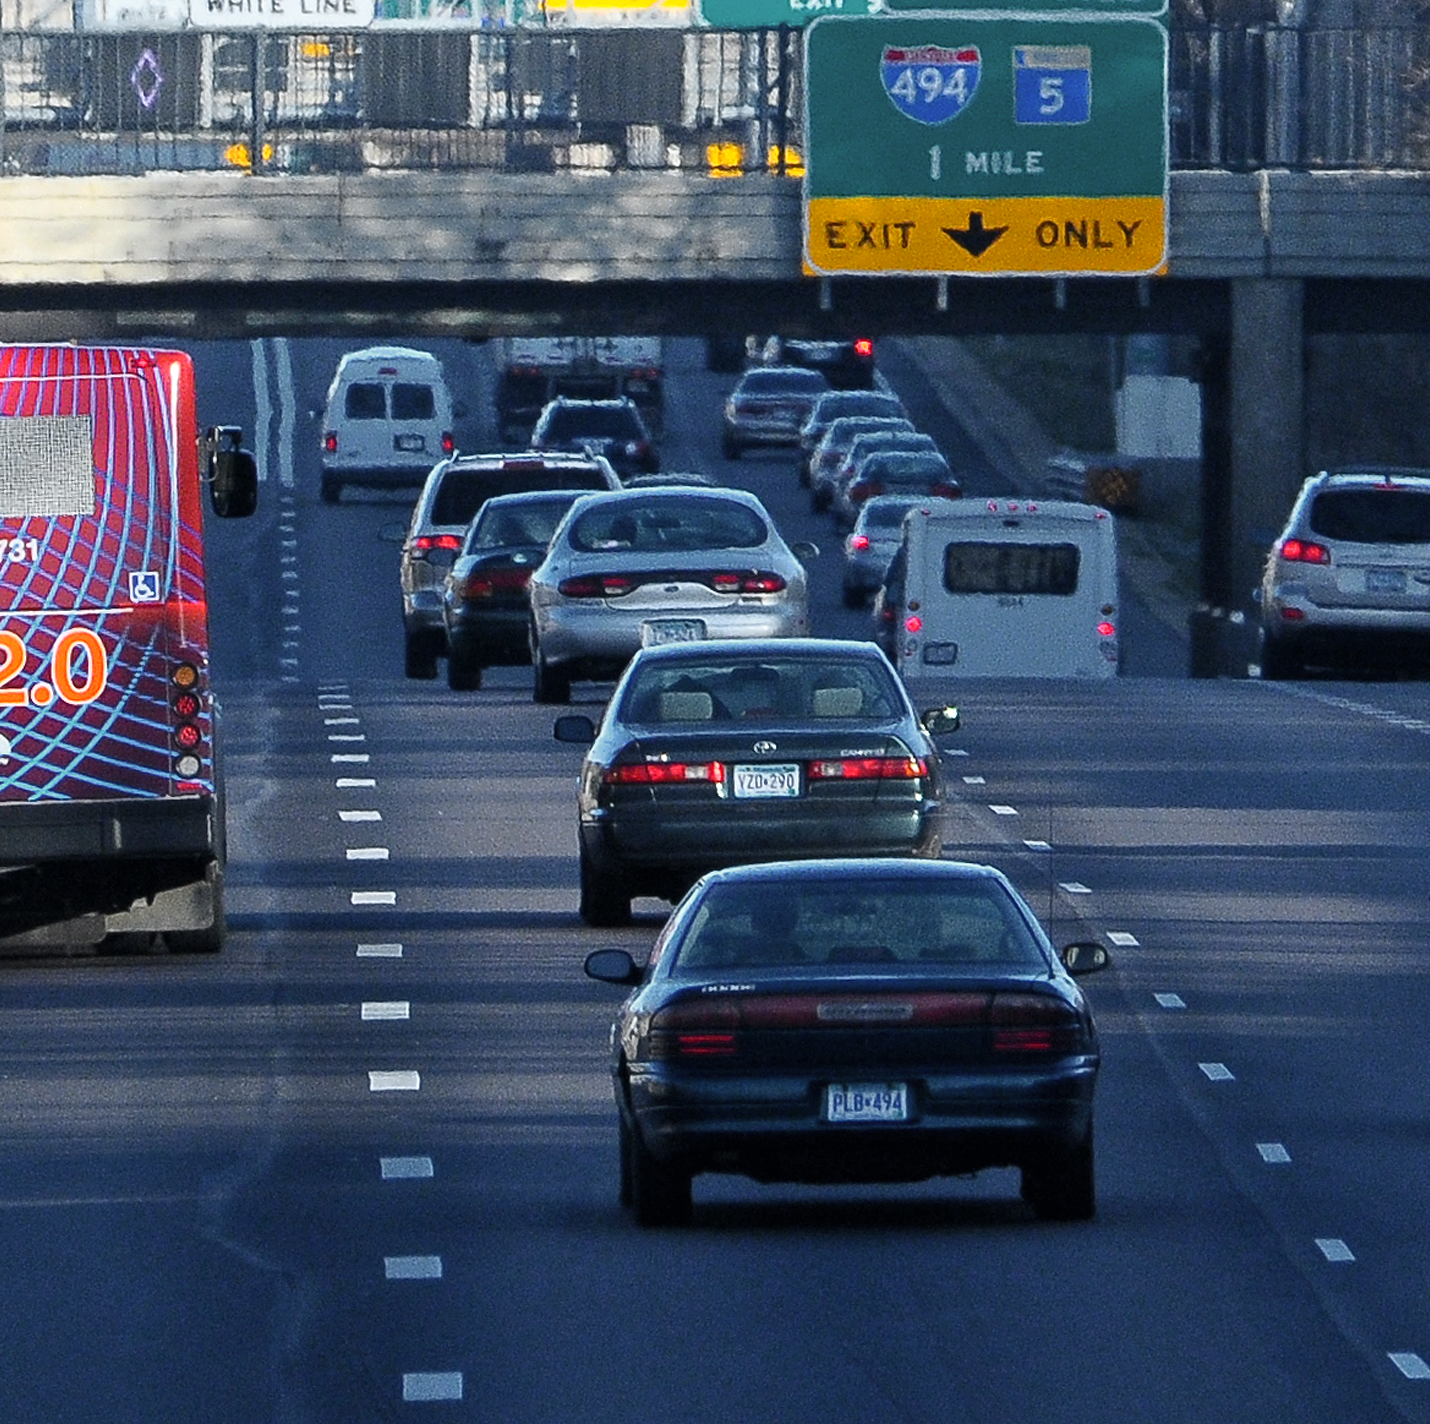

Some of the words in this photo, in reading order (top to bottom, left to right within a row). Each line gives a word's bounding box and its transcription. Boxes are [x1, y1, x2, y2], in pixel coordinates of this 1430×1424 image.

[890, 67, 969, 106] 494
[1039, 77, 1064, 115] 5
[930, 145, 942, 180] 1
[965, 150, 1044, 175] MILE
[825, 221, 916, 249] EXIT
[1035, 220, 1142, 249] ONLY
